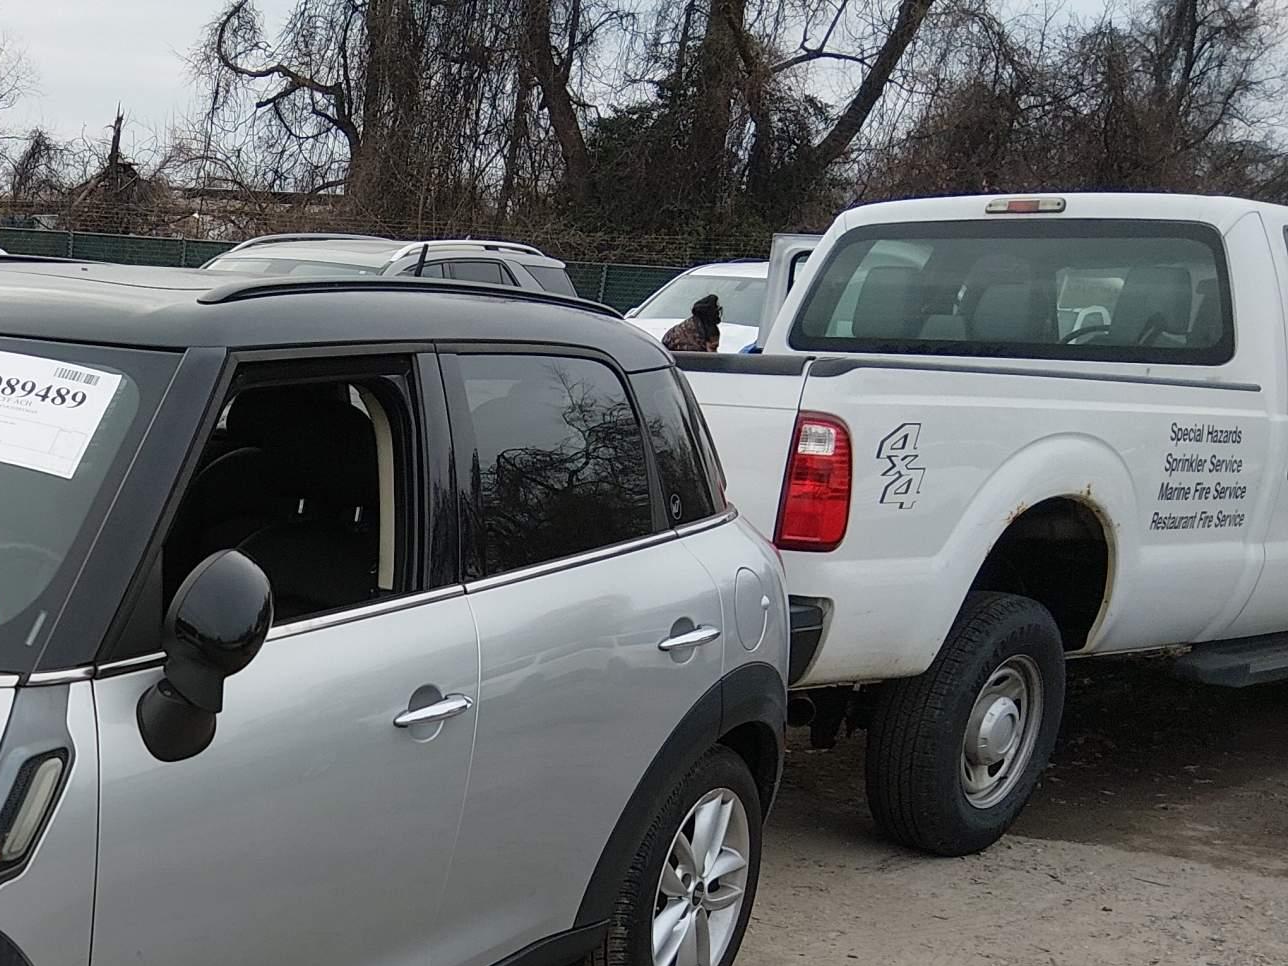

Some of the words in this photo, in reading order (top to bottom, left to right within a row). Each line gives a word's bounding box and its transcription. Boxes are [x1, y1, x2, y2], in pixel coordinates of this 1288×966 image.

[1169, 422, 1205, 447] Special
[1206, 424, 1242, 444] Hazards
[1164, 453, 1207, 477] Sprinkler
[1208, 454, 1243, 473] Service
[1157, 481, 1192, 501] Marine
[1192, 481, 1212, 501] Fire
[1212, 481, 1247, 501] Service
[1149, 512, 1197, 530] Restaurant
[1197, 511, 1214, 529] Fire
[1214, 510, 1245, 529] Service
